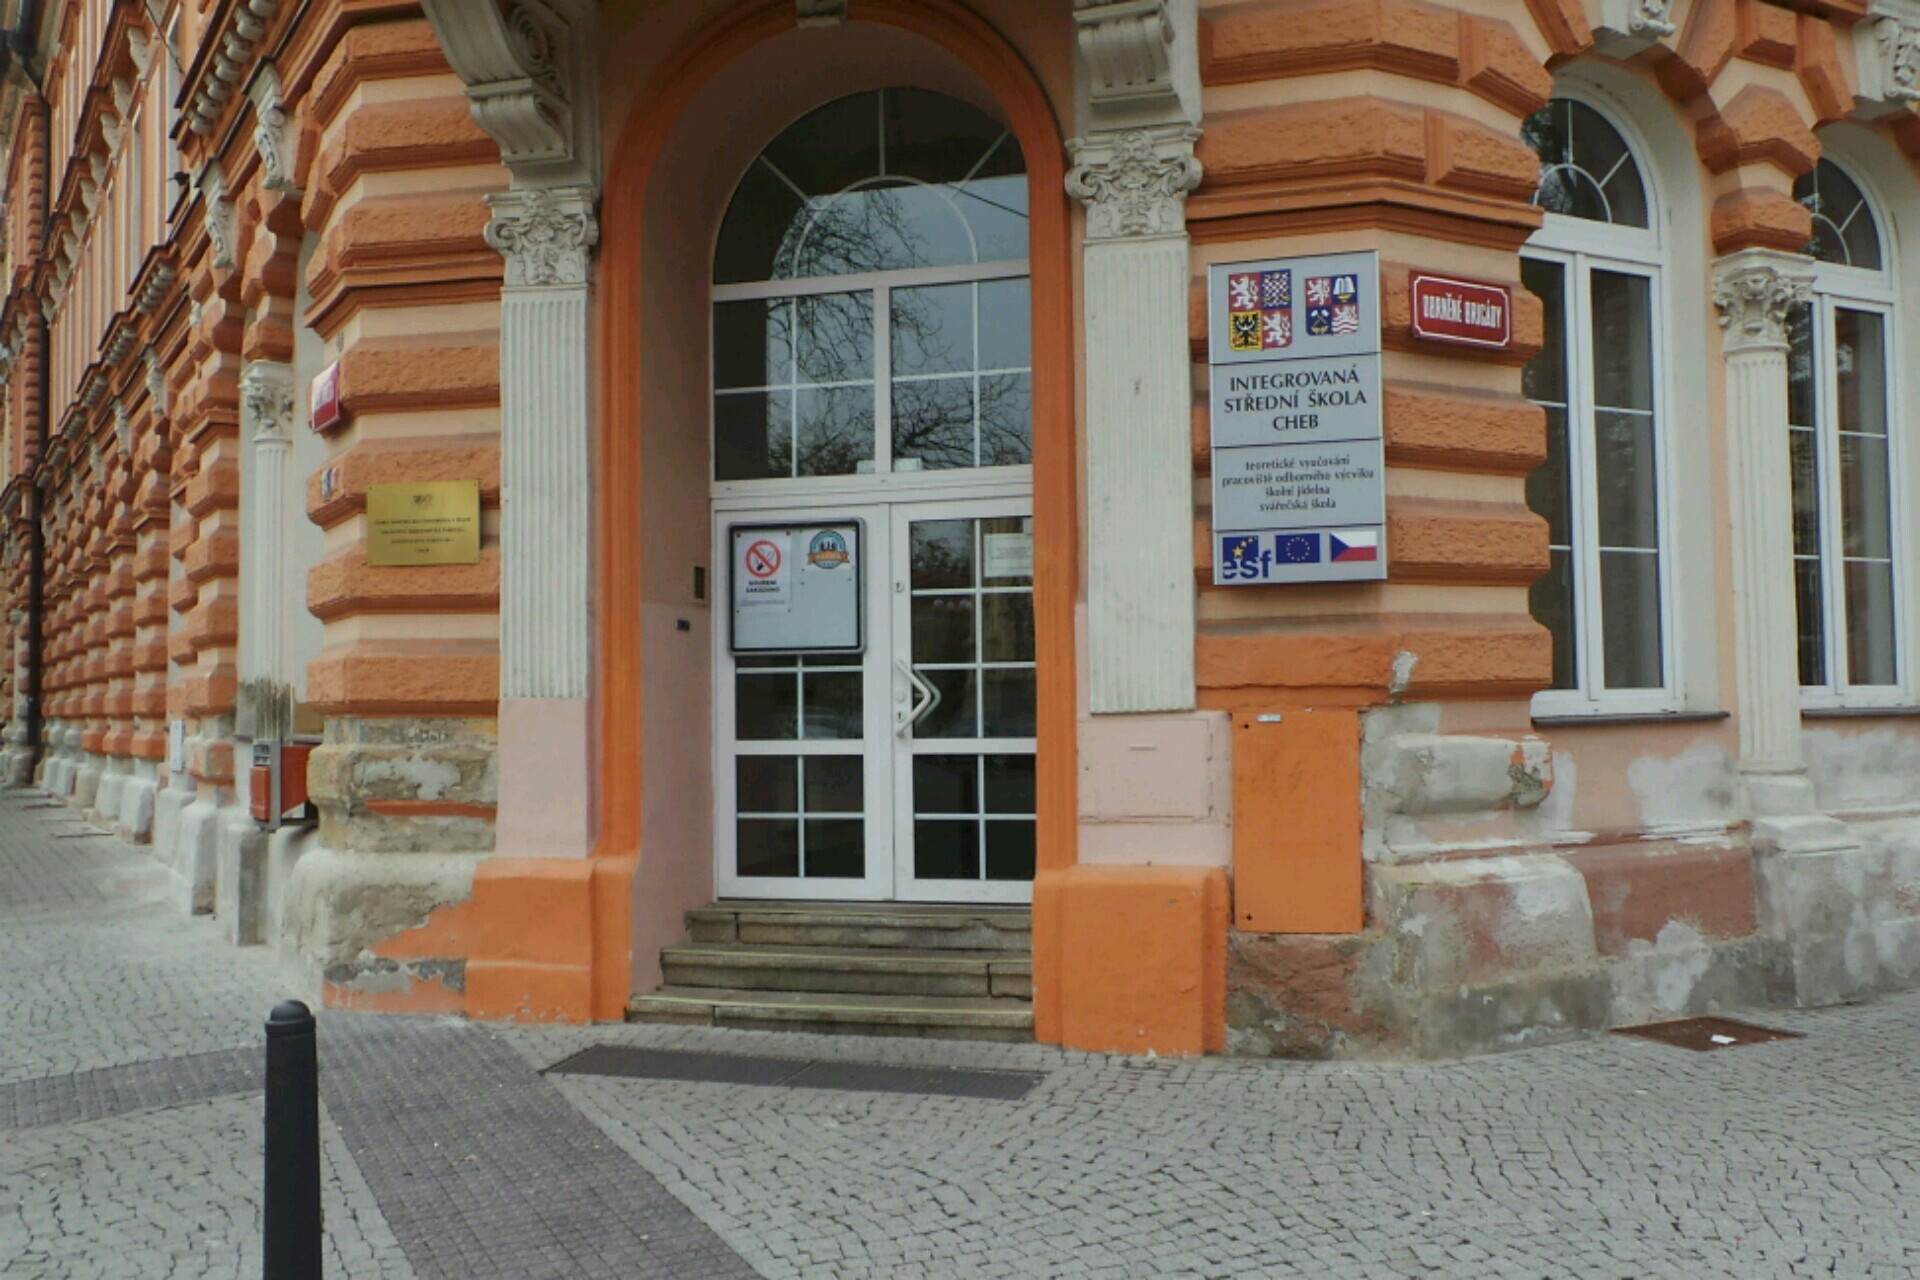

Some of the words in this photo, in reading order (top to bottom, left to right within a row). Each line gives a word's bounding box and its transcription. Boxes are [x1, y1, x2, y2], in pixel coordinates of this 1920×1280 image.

[1422, 291, 1463, 323] OBRNĚNÉ
[1464, 299, 1502, 329] BRIGÁDY
[1230, 365, 1360, 392] INTEGROVANÁ
[1224, 389, 1299, 414] STŘEDNÍ
[1308, 387, 1367, 408] ŠKOLA
[1272, 414, 1319, 431] CHEB
[1245, 458, 1295, 471] teoretické
[1299, 454, 1350, 471] vyučování
[1222, 472, 1273, 488] pracoviště
[1275, 469, 1331, 483] odborného
[1334, 467, 1374, 482] výcviku
[1265, 485, 1295, 498] školní
[1297, 484, 1331, 499] jídelna
[1259, 498, 1308, 513] svářečská
[1311, 497, 1337, 510] škola
[1222, 549, 1272, 580] esf
